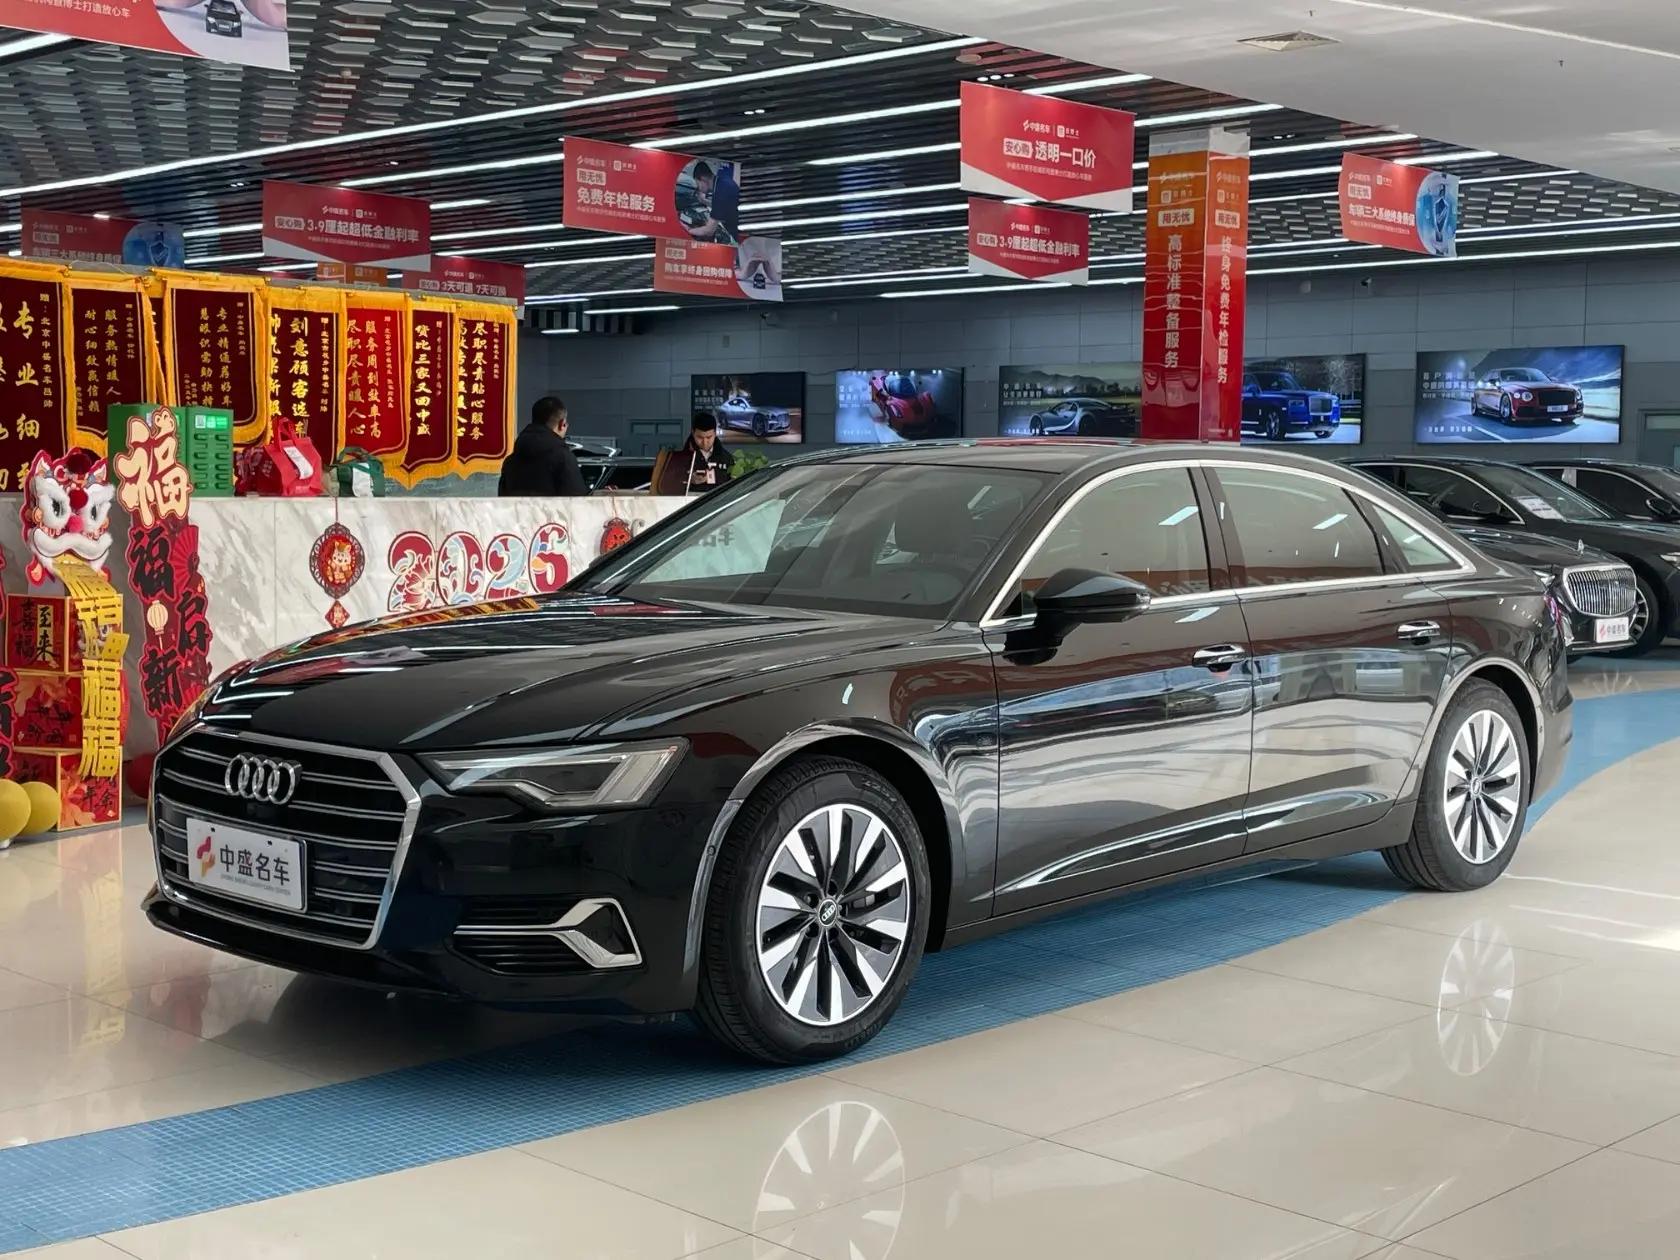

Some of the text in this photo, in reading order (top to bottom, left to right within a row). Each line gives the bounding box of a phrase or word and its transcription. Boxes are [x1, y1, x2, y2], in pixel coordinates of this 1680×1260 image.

[577, 187, 656, 213] 免费年检服务
[1035, 139, 1097, 169] 透明一口价
[306, 218, 420, 244] 3.9厘起超低金融利率
[1164, 233, 1183, 369] 高标准整备服务
[1217, 235, 1233, 384] 终身免费年检服务
[104, 309, 122, 406] 服务热情暖人
[346, 319, 367, 436] 尽职尽责暖人心
[470, 321, 489, 441] 尽职尽责贴心服务
[115, 407, 194, 527] 福
[387, 521, 571, 613] 2026
[219, 844, 290, 886] 中盛名车
